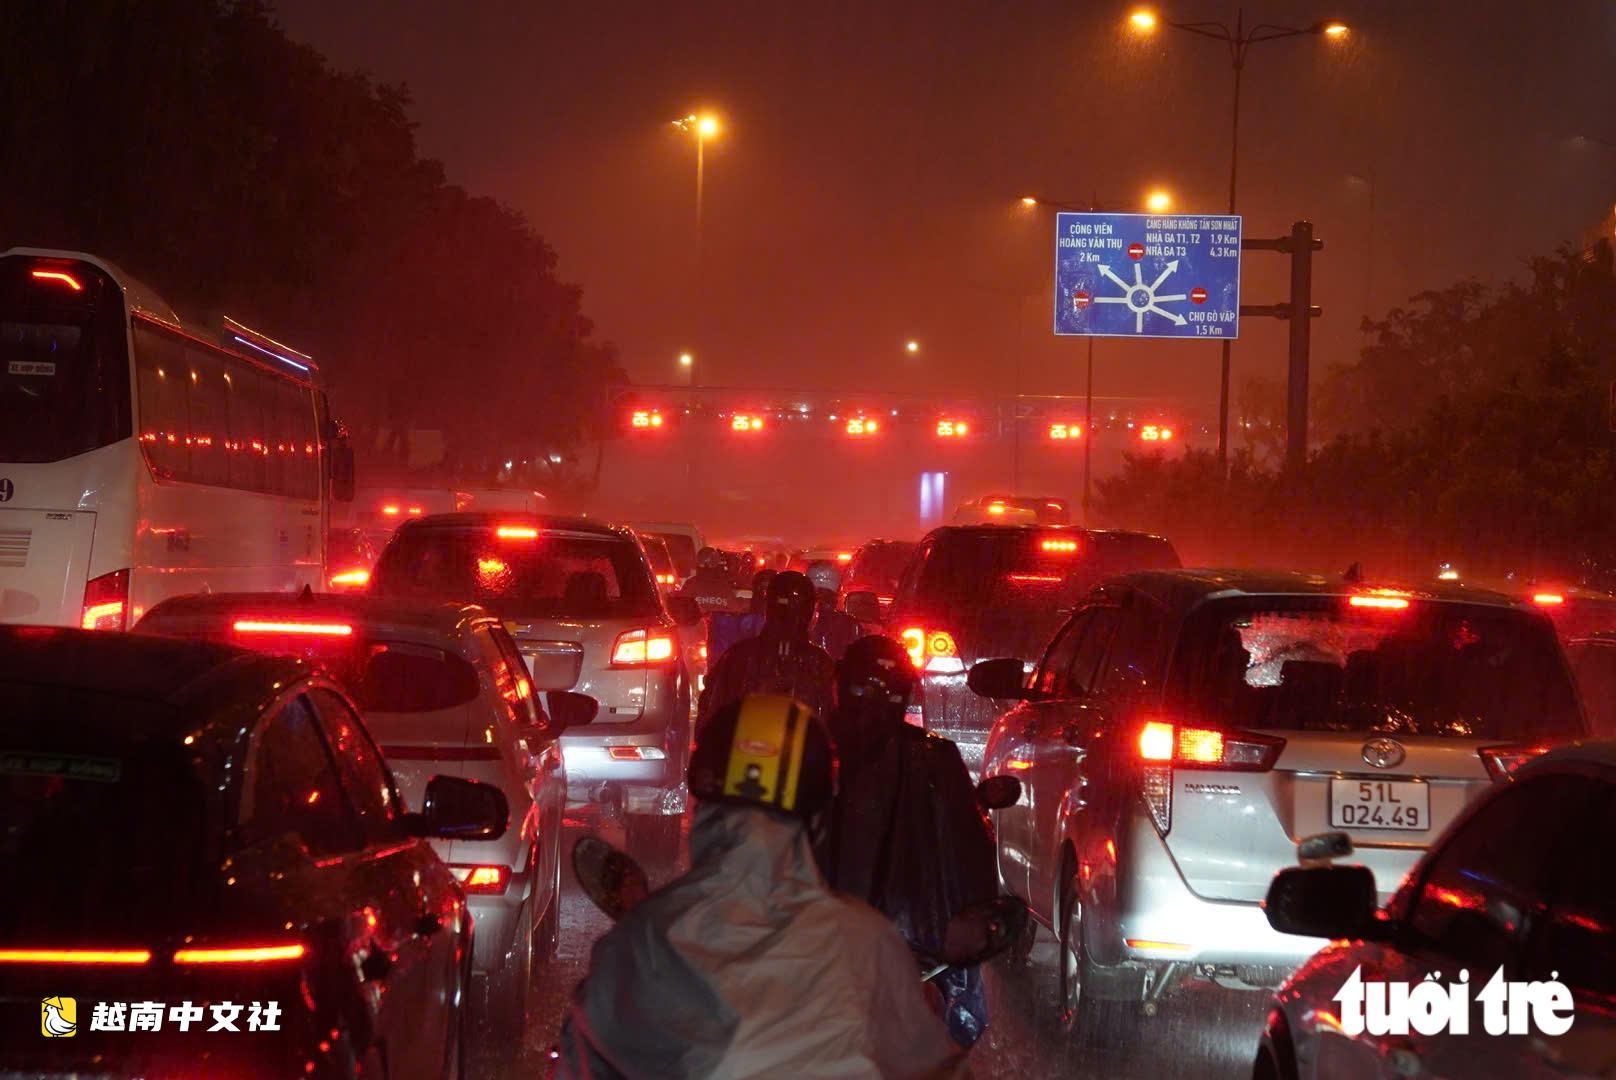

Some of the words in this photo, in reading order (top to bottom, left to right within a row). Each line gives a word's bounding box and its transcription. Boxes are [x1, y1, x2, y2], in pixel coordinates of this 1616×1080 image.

[1070, 222, 1092, 235] CÔNG
[1094, 222, 1113, 235] VIÊN
[1060, 235, 1087, 248] HOÀNG
[1088, 236, 1105, 248] VĂN
[1106, 239, 1123, 250] THỤ
[1146, 230, 1163, 243] NHÀ
[1164, 233, 1175, 243] GA
[1190, 234, 1201, 244] T2
[1224, 234, 1238, 244] Km
[1080, 252, 1086, 262] 2
[1086, 252, 1100, 262] Km
[1145, 243, 1162, 256] NHÀ
[1164, 246, 1175, 256] GA
[1176, 246, 1187, 257] T3
[1223, 247, 1238, 257] Km
[1188, 311, 1206, 323] CHỢ
[1207, 309, 1218, 322] GÒ
[1209, 325, 1223, 335] Km
[697, 596, 728, 607] ENEOS
[1359, 782, 1401, 803] 51L
[1341, 804, 1419, 827] 024.49
